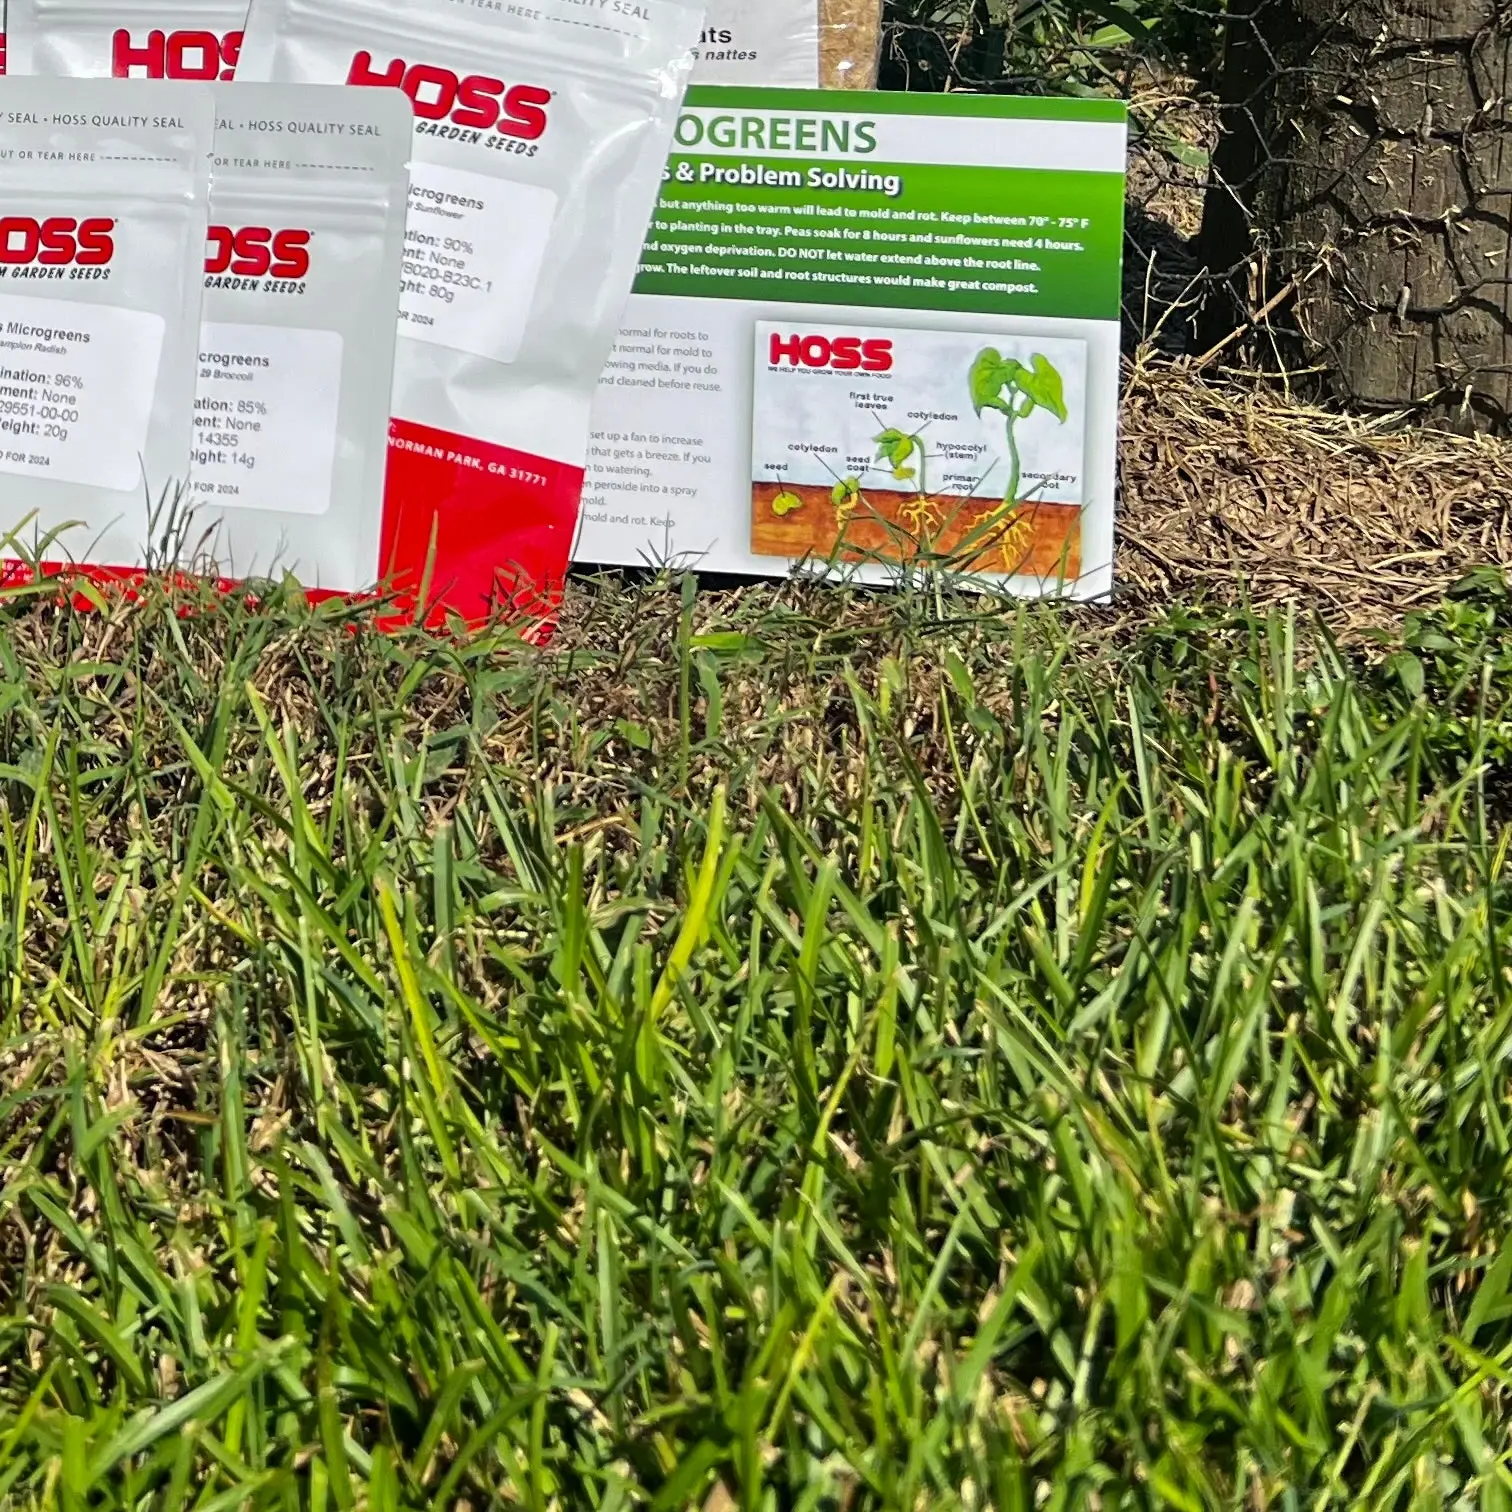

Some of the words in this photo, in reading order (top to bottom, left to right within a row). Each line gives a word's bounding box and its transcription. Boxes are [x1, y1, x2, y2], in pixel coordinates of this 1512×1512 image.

[612, 1, 650, 20] SEAL
[705, 49, 757, 60] nattes
[346, 50, 553, 140] HOSS
[8, 112, 38, 124] SEAL
[52, 114, 87, 126] HOSS
[91, 116, 148, 129] QUALITY
[153, 117, 184, 129] SEAL
[248, 121, 282, 131] HOSS
[288, 122, 344, 135] QUALITY
[350, 125, 381, 136] SEAL
[674, 114, 876, 153] OGREENS
[415, 121, 482, 145] GARDEN
[485, 134, 539, 157] SEEDS
[18, 151, 33, 159] OR
[37, 151, 64, 160] TEAR
[68, 152, 96, 161] HERE
[234, 158, 259, 167] TEAR
[264, 160, 290, 169] HERE
[701, 163, 800, 186] Problem
[807, 168, 900, 195] Solving
[660, 200, 680, 209] but
[682, 201, 733, 214] anything
[736, 204, 755, 212] too
[758, 205, 790, 214] warm
[793, 205, 814, 215] will
[816, 206, 841, 217] lead
[859, 209, 889, 219] mold
[892, 210, 915, 220] and
[941, 212, 971, 226] Keep
[973, 214, 1026, 226] between
[670, 221, 718, 235] planting
[734, 224, 754, 234] the
[785, 226, 811, 237] Peas
[814, 228, 840, 238] soak
[843, 228, 860, 239] for
[872, 231, 907, 242] hours
[909, 233, 932, 243] and
[934, 234, 999, 247] sunflowers
[1002, 238, 1032, 248] need
[444, 238, 474, 254] 90%
[661, 244, 702, 256] oxygen
[704, 245, 775, 258] deprivation.
[778, 248, 797, 257] DO
[799, 249, 824, 259] NOT
[845, 252, 877, 262] water
[880, 254, 922, 265] extend
[924, 256, 960, 267] above
[963, 257, 983, 268] the
[986, 259, 1011, 270] root
[12, 266, 64, 279] GARDEN
[69, 268, 110, 280] SEEDS
[666, 264, 688, 274] The
[690, 265, 735, 277] leftover
[760, 269, 782, 279] and
[785, 270, 809, 280] root
[812, 271, 871, 284] structures
[913, 278, 945, 288] make
[948, 279, 980, 291] great
[982, 281, 1038, 294] compost.
[205, 277, 258, 290] GARDEN
[264, 282, 306, 294] SEEDS
[429, 284, 455, 303] 80g
[7, 321, 91, 343] Microgreens
[670, 331, 696, 340] roots
[35, 342, 66, 355] Radish
[619, 346, 654, 354] normal
[673, 348, 700, 357] mold
[770, 333, 893, 371] HOSS
[55, 374, 83, 389] 96%
[617, 377, 656, 387] cleaned
[658, 379, 691, 389] before
[42, 390, 76, 405] None
[238, 401, 266, 414] 85%
[226, 417, 261, 431] None
[44, 424, 68, 440] 20g
[662, 435, 703, 446] increase
[6, 450, 26, 463] FOR
[231, 454, 255, 468] 14g
[591, 448, 611, 457] that
[613, 449, 634, 460] gets
[447, 451, 483, 471] PARK,
[487, 460, 506, 477] GA
[509, 467, 547, 486] 31771
[594, 481, 638, 491] peroxide
[670, 487, 697, 496] spray
